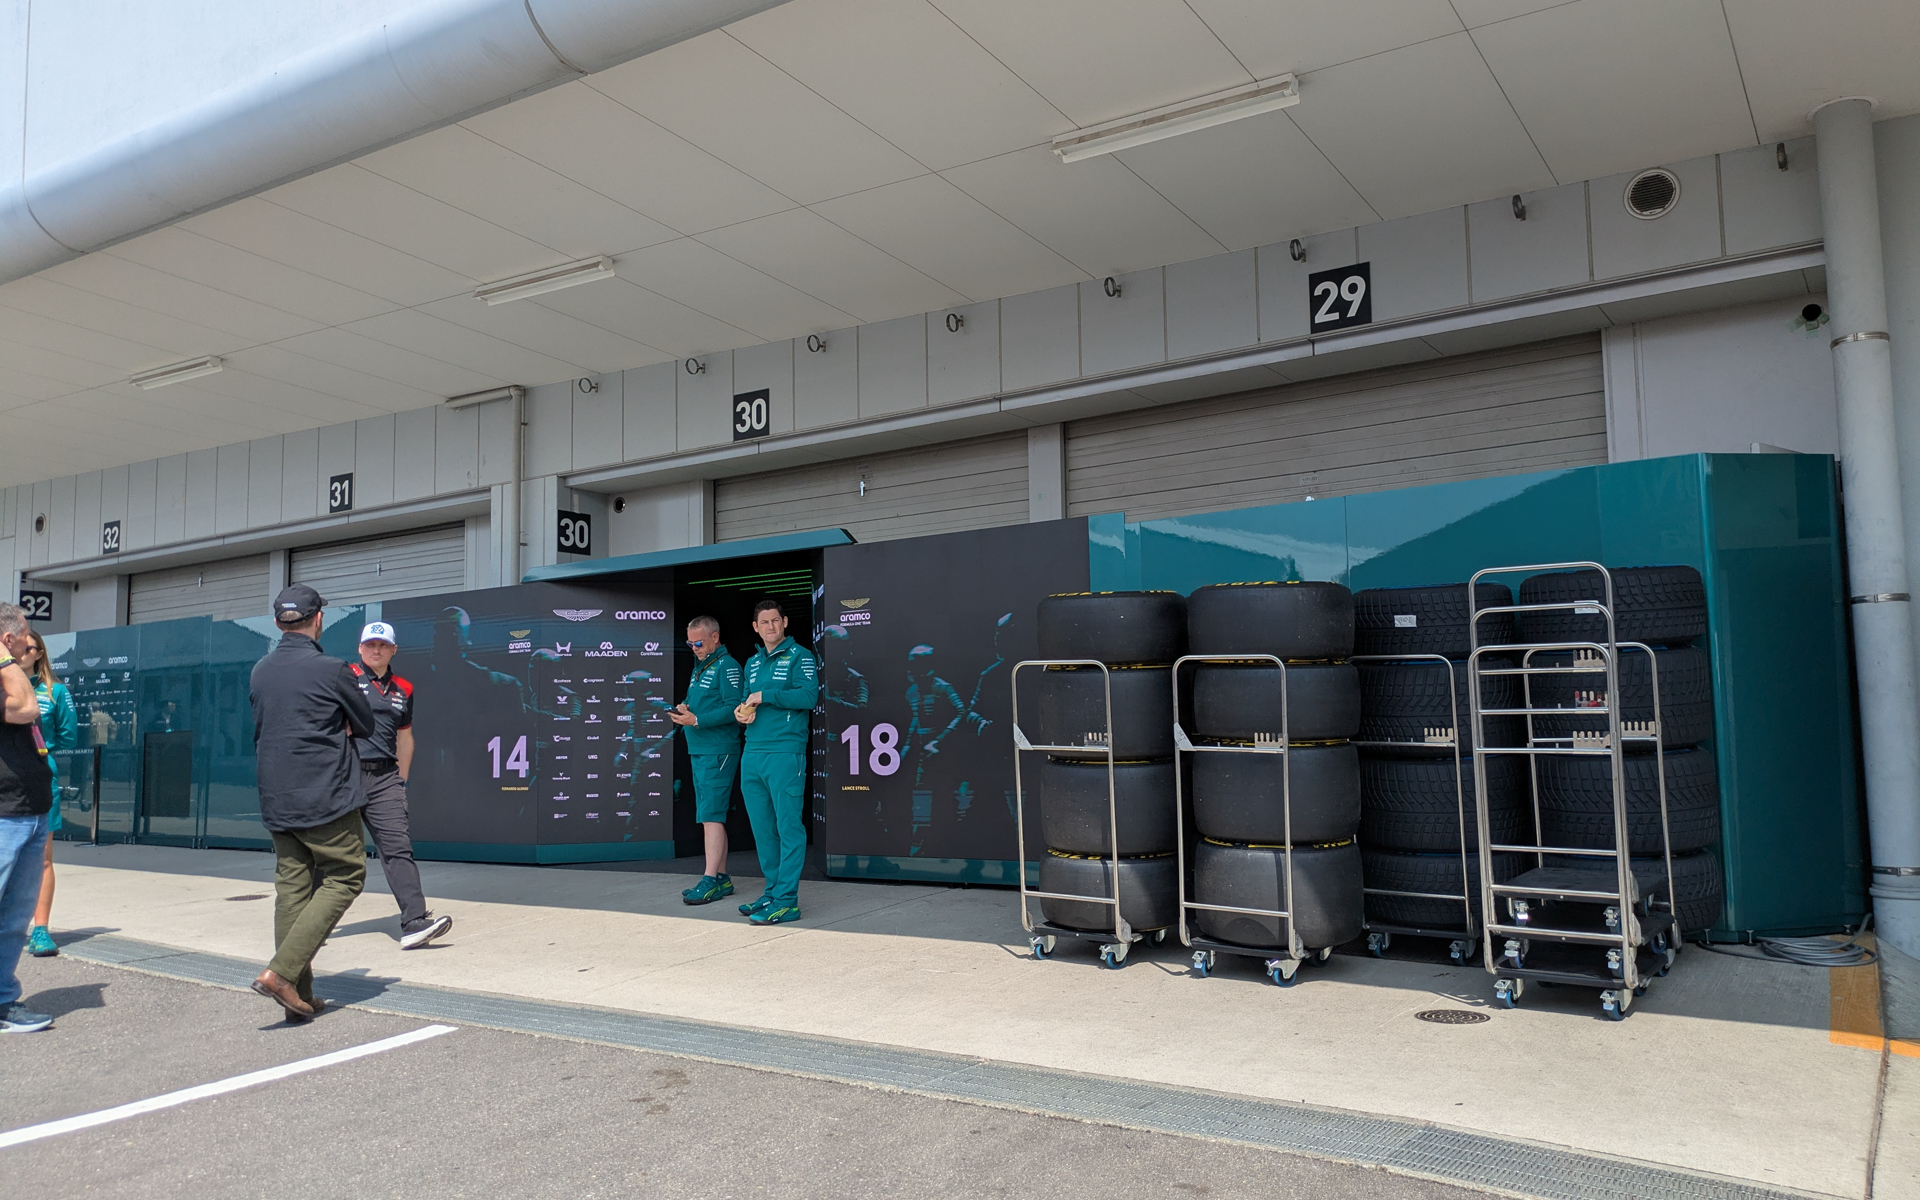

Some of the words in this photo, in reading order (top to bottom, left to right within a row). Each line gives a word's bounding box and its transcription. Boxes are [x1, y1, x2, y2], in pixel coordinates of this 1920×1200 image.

[1313, 275, 1366, 324] 29
[735, 398, 767, 433] 30
[331, 480, 349, 507] 31
[104, 526, 119, 549] 32
[560, 518, 589, 549] 30
[22, 595, 51, 617] 32
[615, 610, 666, 620] aramco
[840, 612, 871, 622] aramco
[508, 642, 531, 650] aramco
[108, 656, 128, 665] aramco
[487, 735, 530, 778] 14
[841, 722, 901, 776] 18
